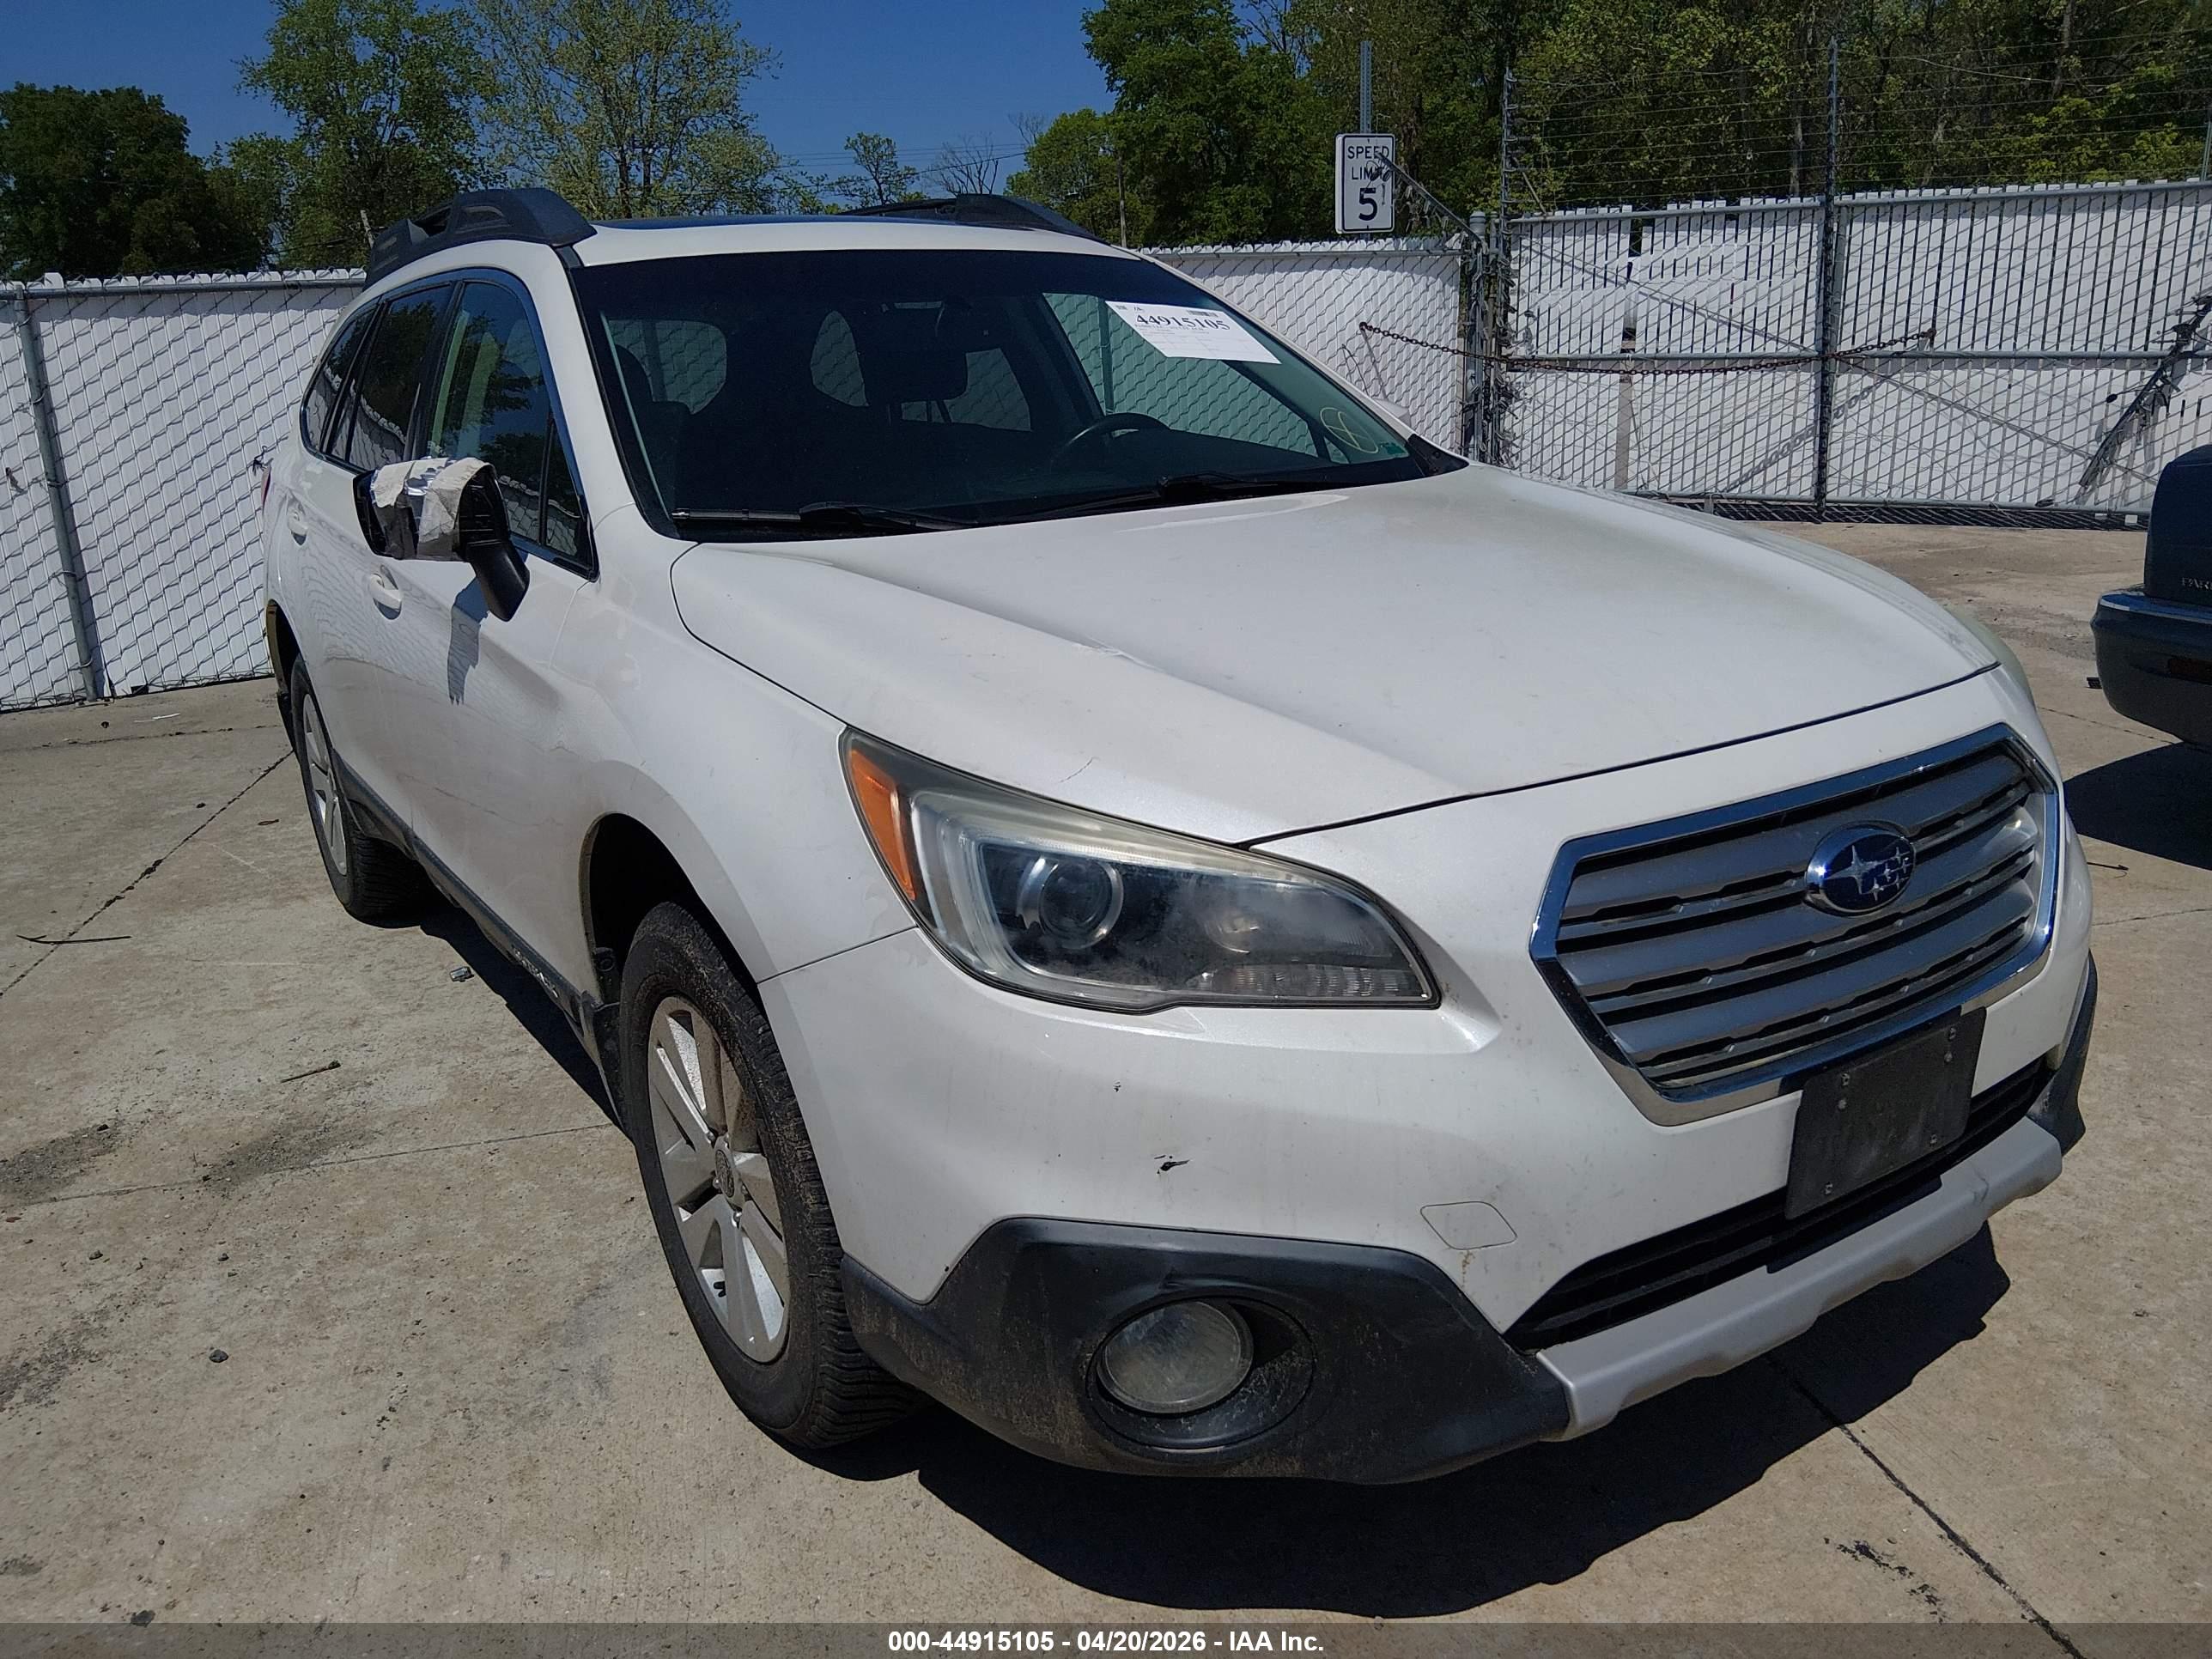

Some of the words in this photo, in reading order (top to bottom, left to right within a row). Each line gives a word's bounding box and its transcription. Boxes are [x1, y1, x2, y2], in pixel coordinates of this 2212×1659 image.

[1347, 145, 1389, 159] SPEED
[1352, 167, 1384, 180] LIMT
[1358, 187, 1377, 221] 5
[1136, 314, 1231, 331] 44915105
